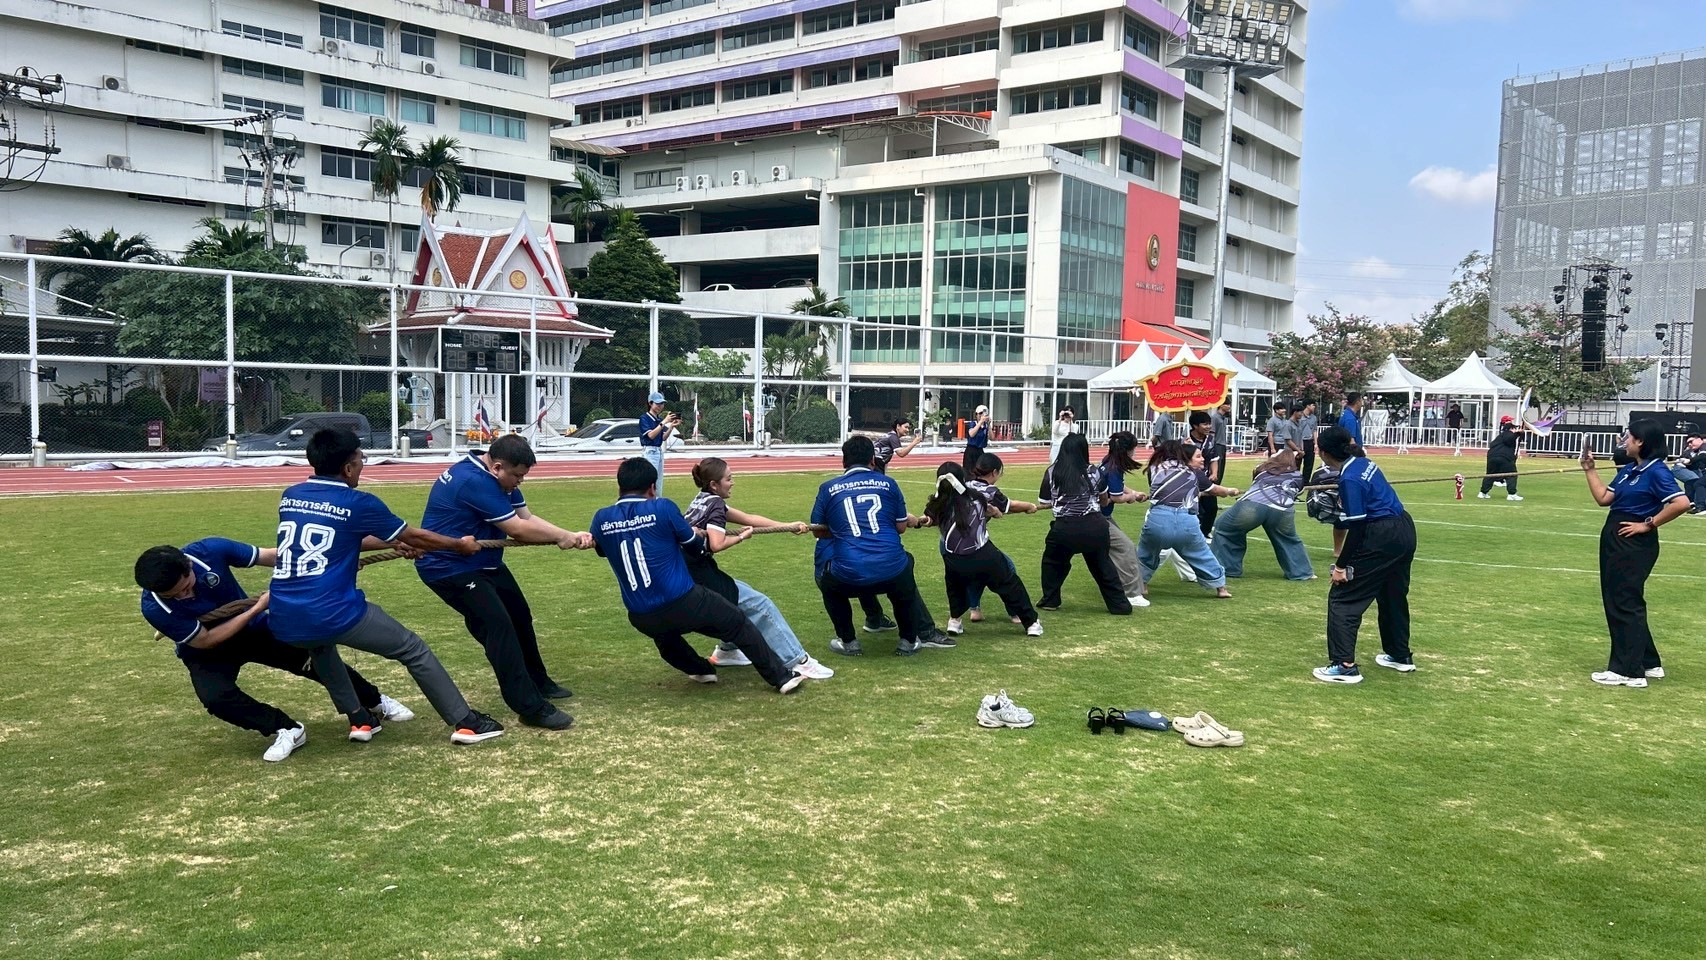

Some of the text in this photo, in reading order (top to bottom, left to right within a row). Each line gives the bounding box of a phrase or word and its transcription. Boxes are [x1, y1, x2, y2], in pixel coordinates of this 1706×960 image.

[279, 497, 352, 517] ริหารการศึกษา
[843, 493, 882, 537] 17
[620, 537, 652, 592] 11
